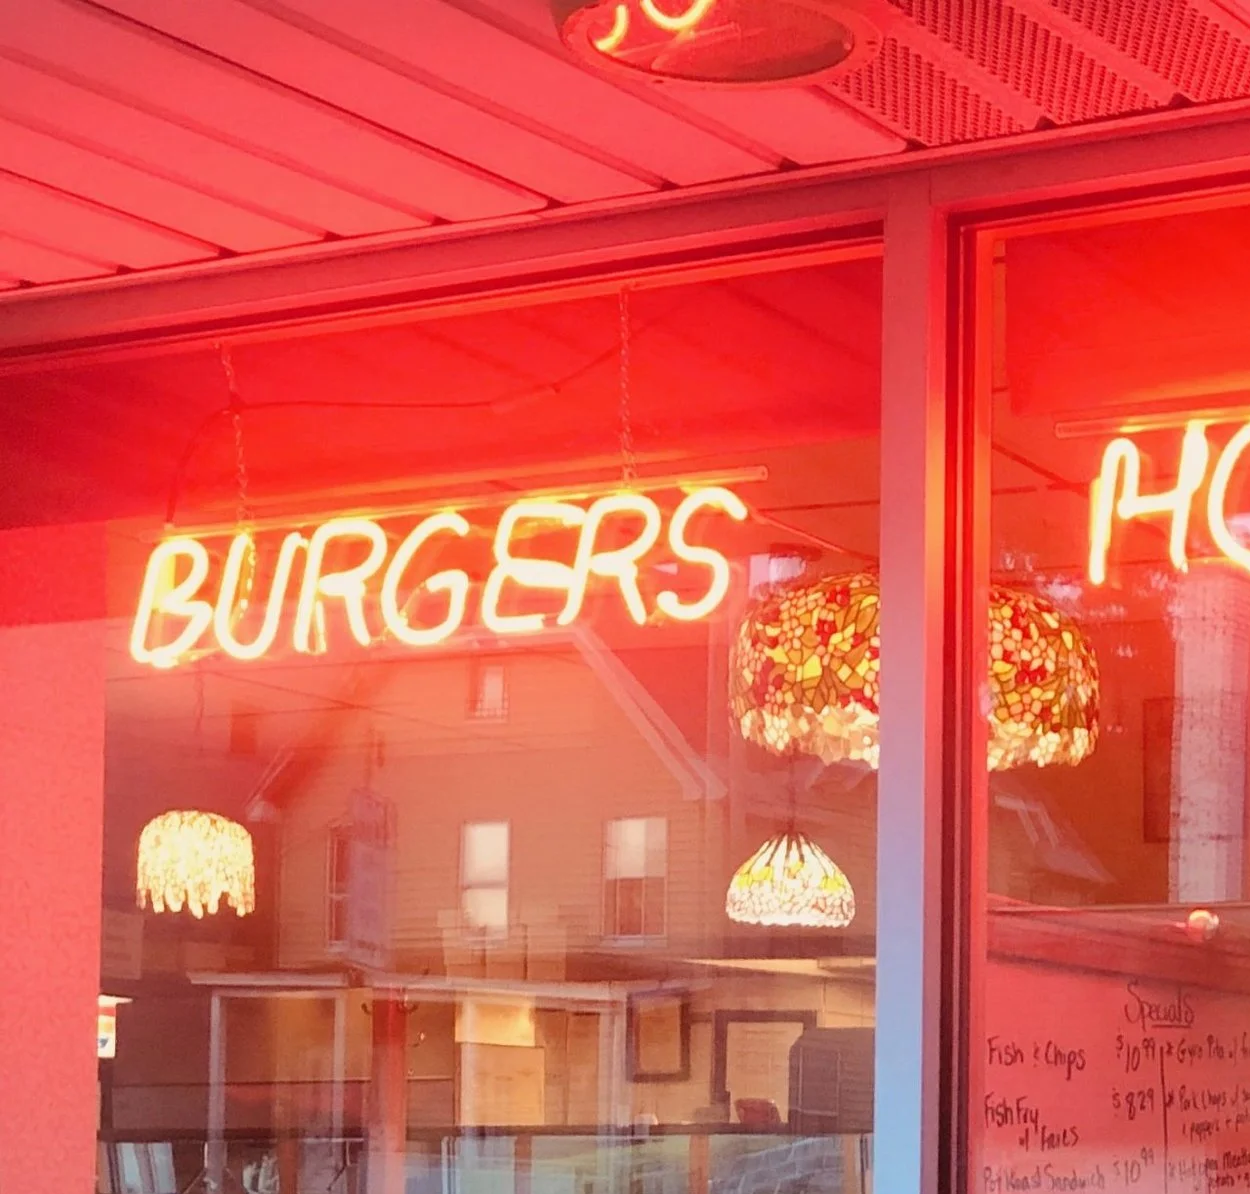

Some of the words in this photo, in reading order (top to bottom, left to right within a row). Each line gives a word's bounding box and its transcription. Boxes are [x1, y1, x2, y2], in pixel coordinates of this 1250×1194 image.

[130, 485, 748, 668] BURGERS
[1124, 979, 1195, 1032] Specials
[987, 1035, 1025, 1066] Fish
[1044, 1040, 1087, 1081] Chips
[984, 1091, 1014, 1128] Fish
[1015, 1096, 1040, 1134] Fry
[1044, 1162, 1106, 1193] Sandwich
